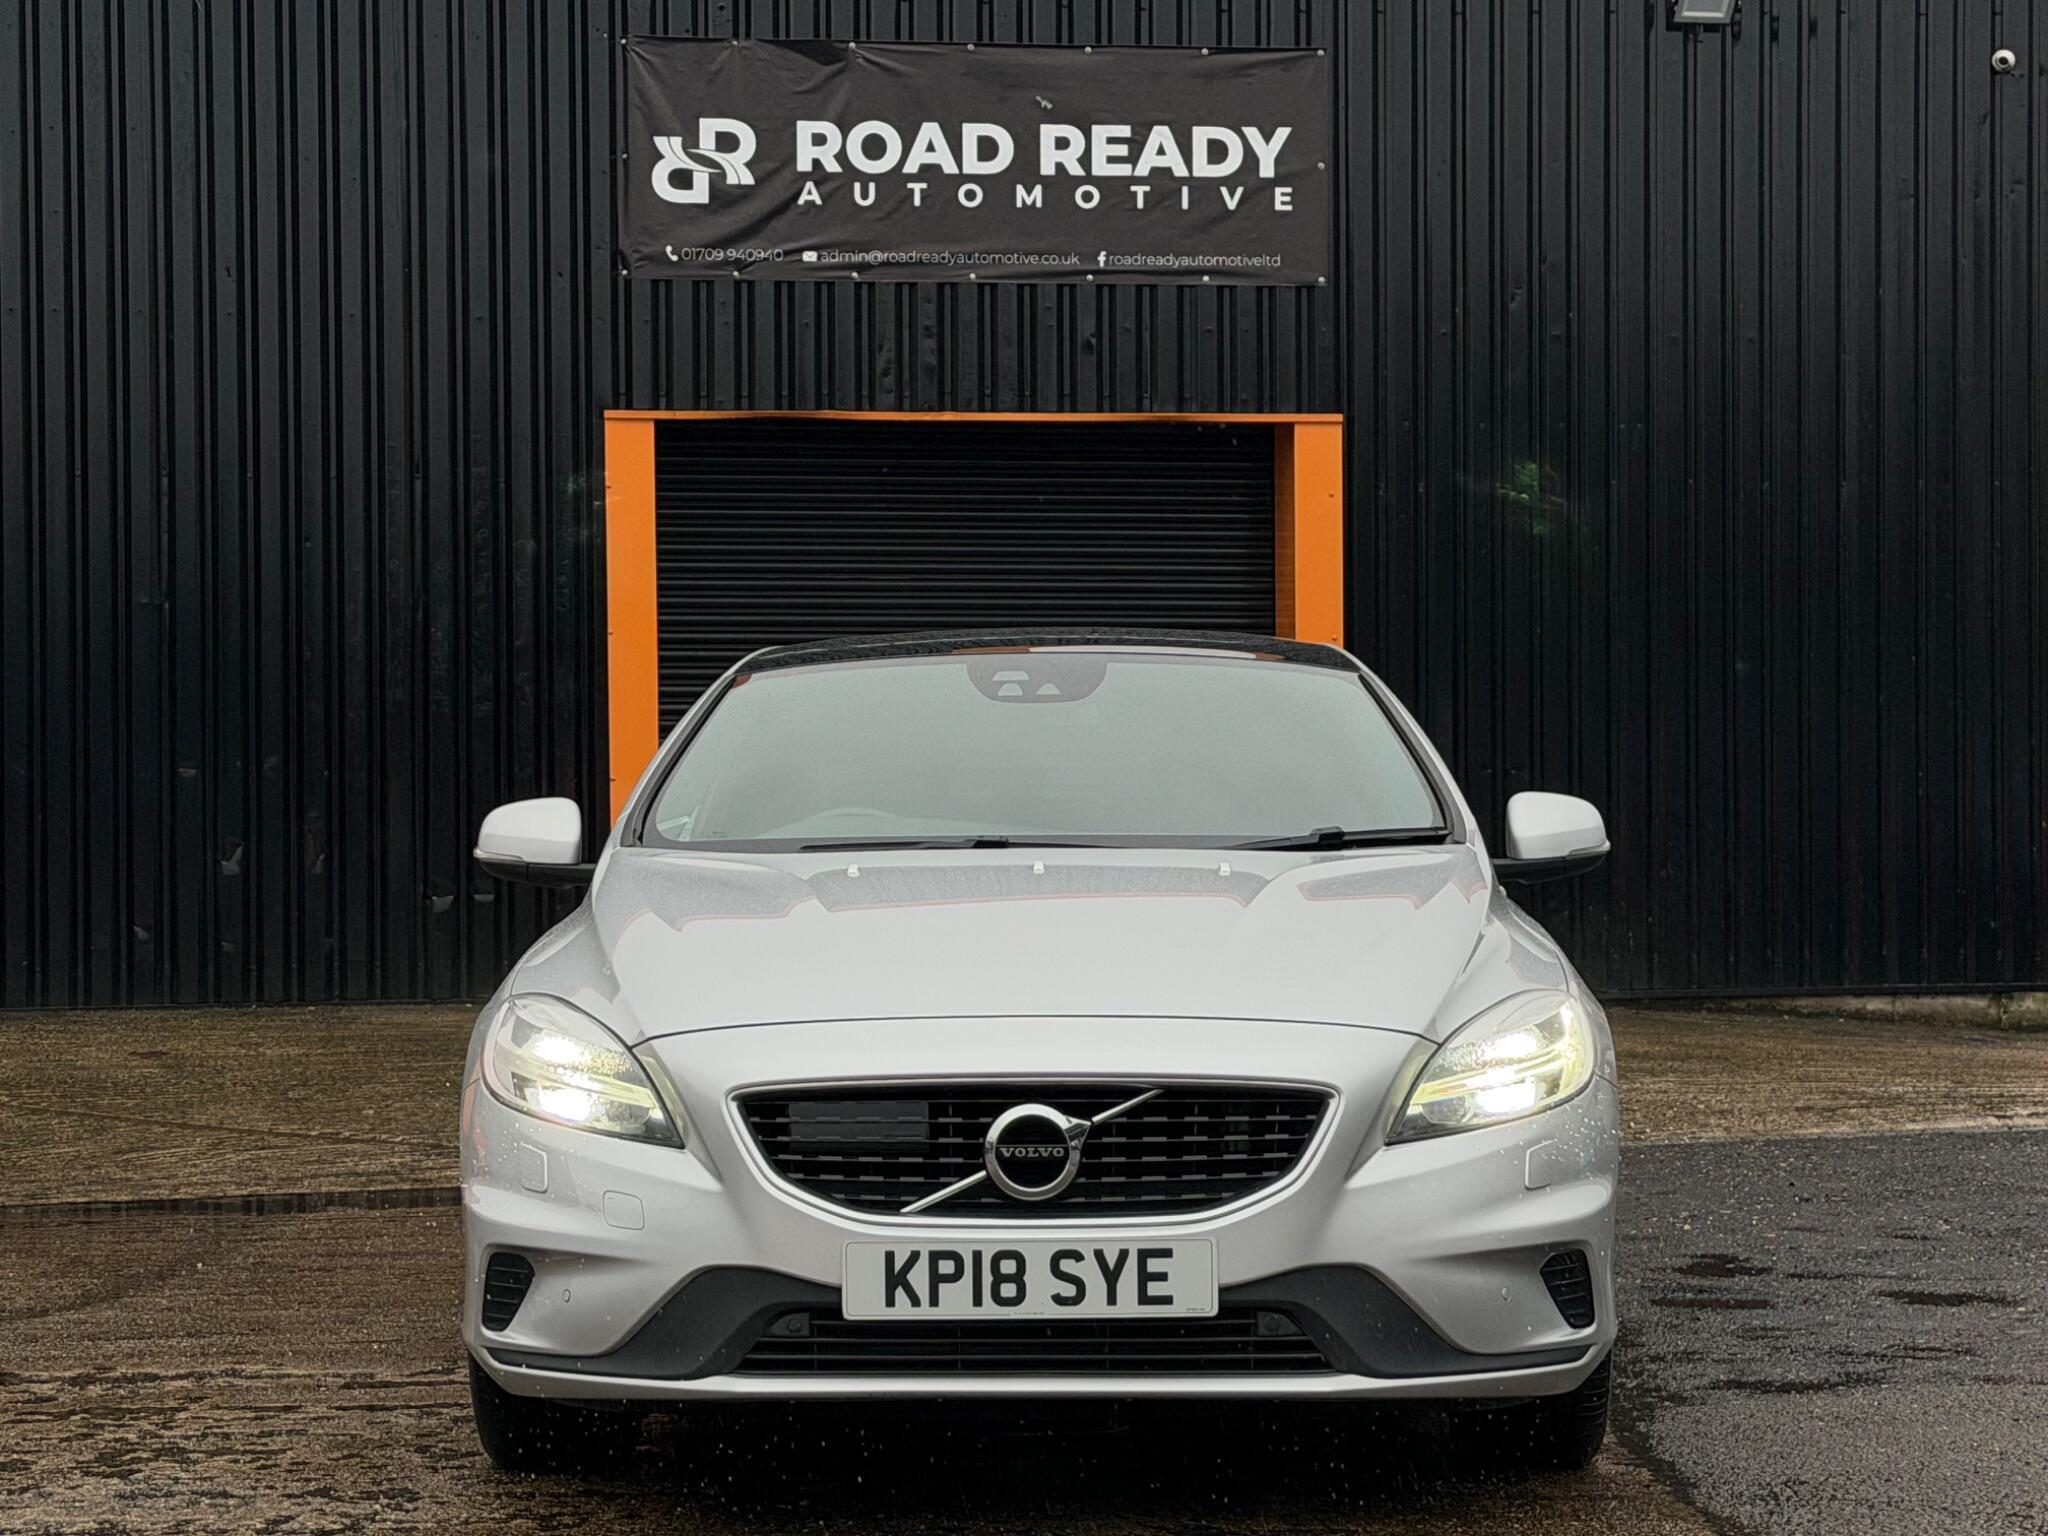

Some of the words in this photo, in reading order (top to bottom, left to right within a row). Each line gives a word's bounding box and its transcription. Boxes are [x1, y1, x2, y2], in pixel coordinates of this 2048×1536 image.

[796, 121, 1014, 174] ROAD
[1039, 123, 1293, 178] READY
[797, 181, 1294, 211] AUTOMOTIVE
[682, 247, 724, 261] 01709
[728, 248, 784, 262] 940940
[820, 250, 1080, 267] admin@roadreadyautomotive.co.uk
[1109, 252, 1281, 268] roadreadyautomotiveltd
[1001, 1146, 1065, 1159] VOLVO
[884, 1249, 1027, 1308] KP18
[1050, 1248, 1174, 1307] SYE
